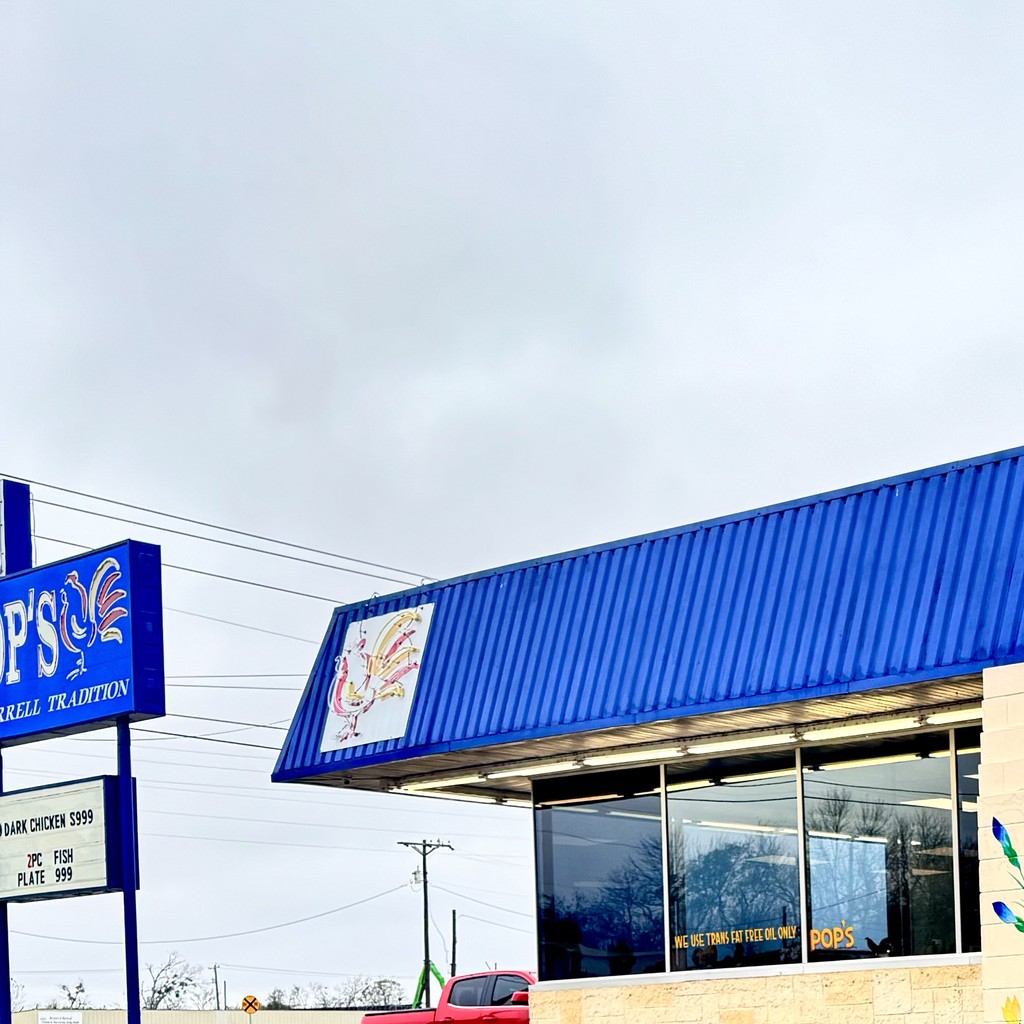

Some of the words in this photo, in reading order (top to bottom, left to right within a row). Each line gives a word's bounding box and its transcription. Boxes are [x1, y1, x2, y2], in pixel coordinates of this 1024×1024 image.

[0, 588, 58, 685] P'S
[48, 679, 129, 712] TRADITION
[4, 819, 28, 836] DARK
[30, 813, 66, 832] CHICKEN
[27, 853, 42, 868] 2PC
[54, 848, 73, 864] FISH
[18, 870, 45, 887] PLATE
[55, 866, 73, 882] 999
[674, 935, 689, 949] WE
[690, 932, 705, 948] USE
[706, 931, 730, 946] TRANS
[731, 929, 743, 943] FAT
[745, 927, 764, 942] FREE
[765, 926, 777, 941] OIL
[777, 925, 797, 940] ONLY
[810, 919, 855, 951] POP'S
